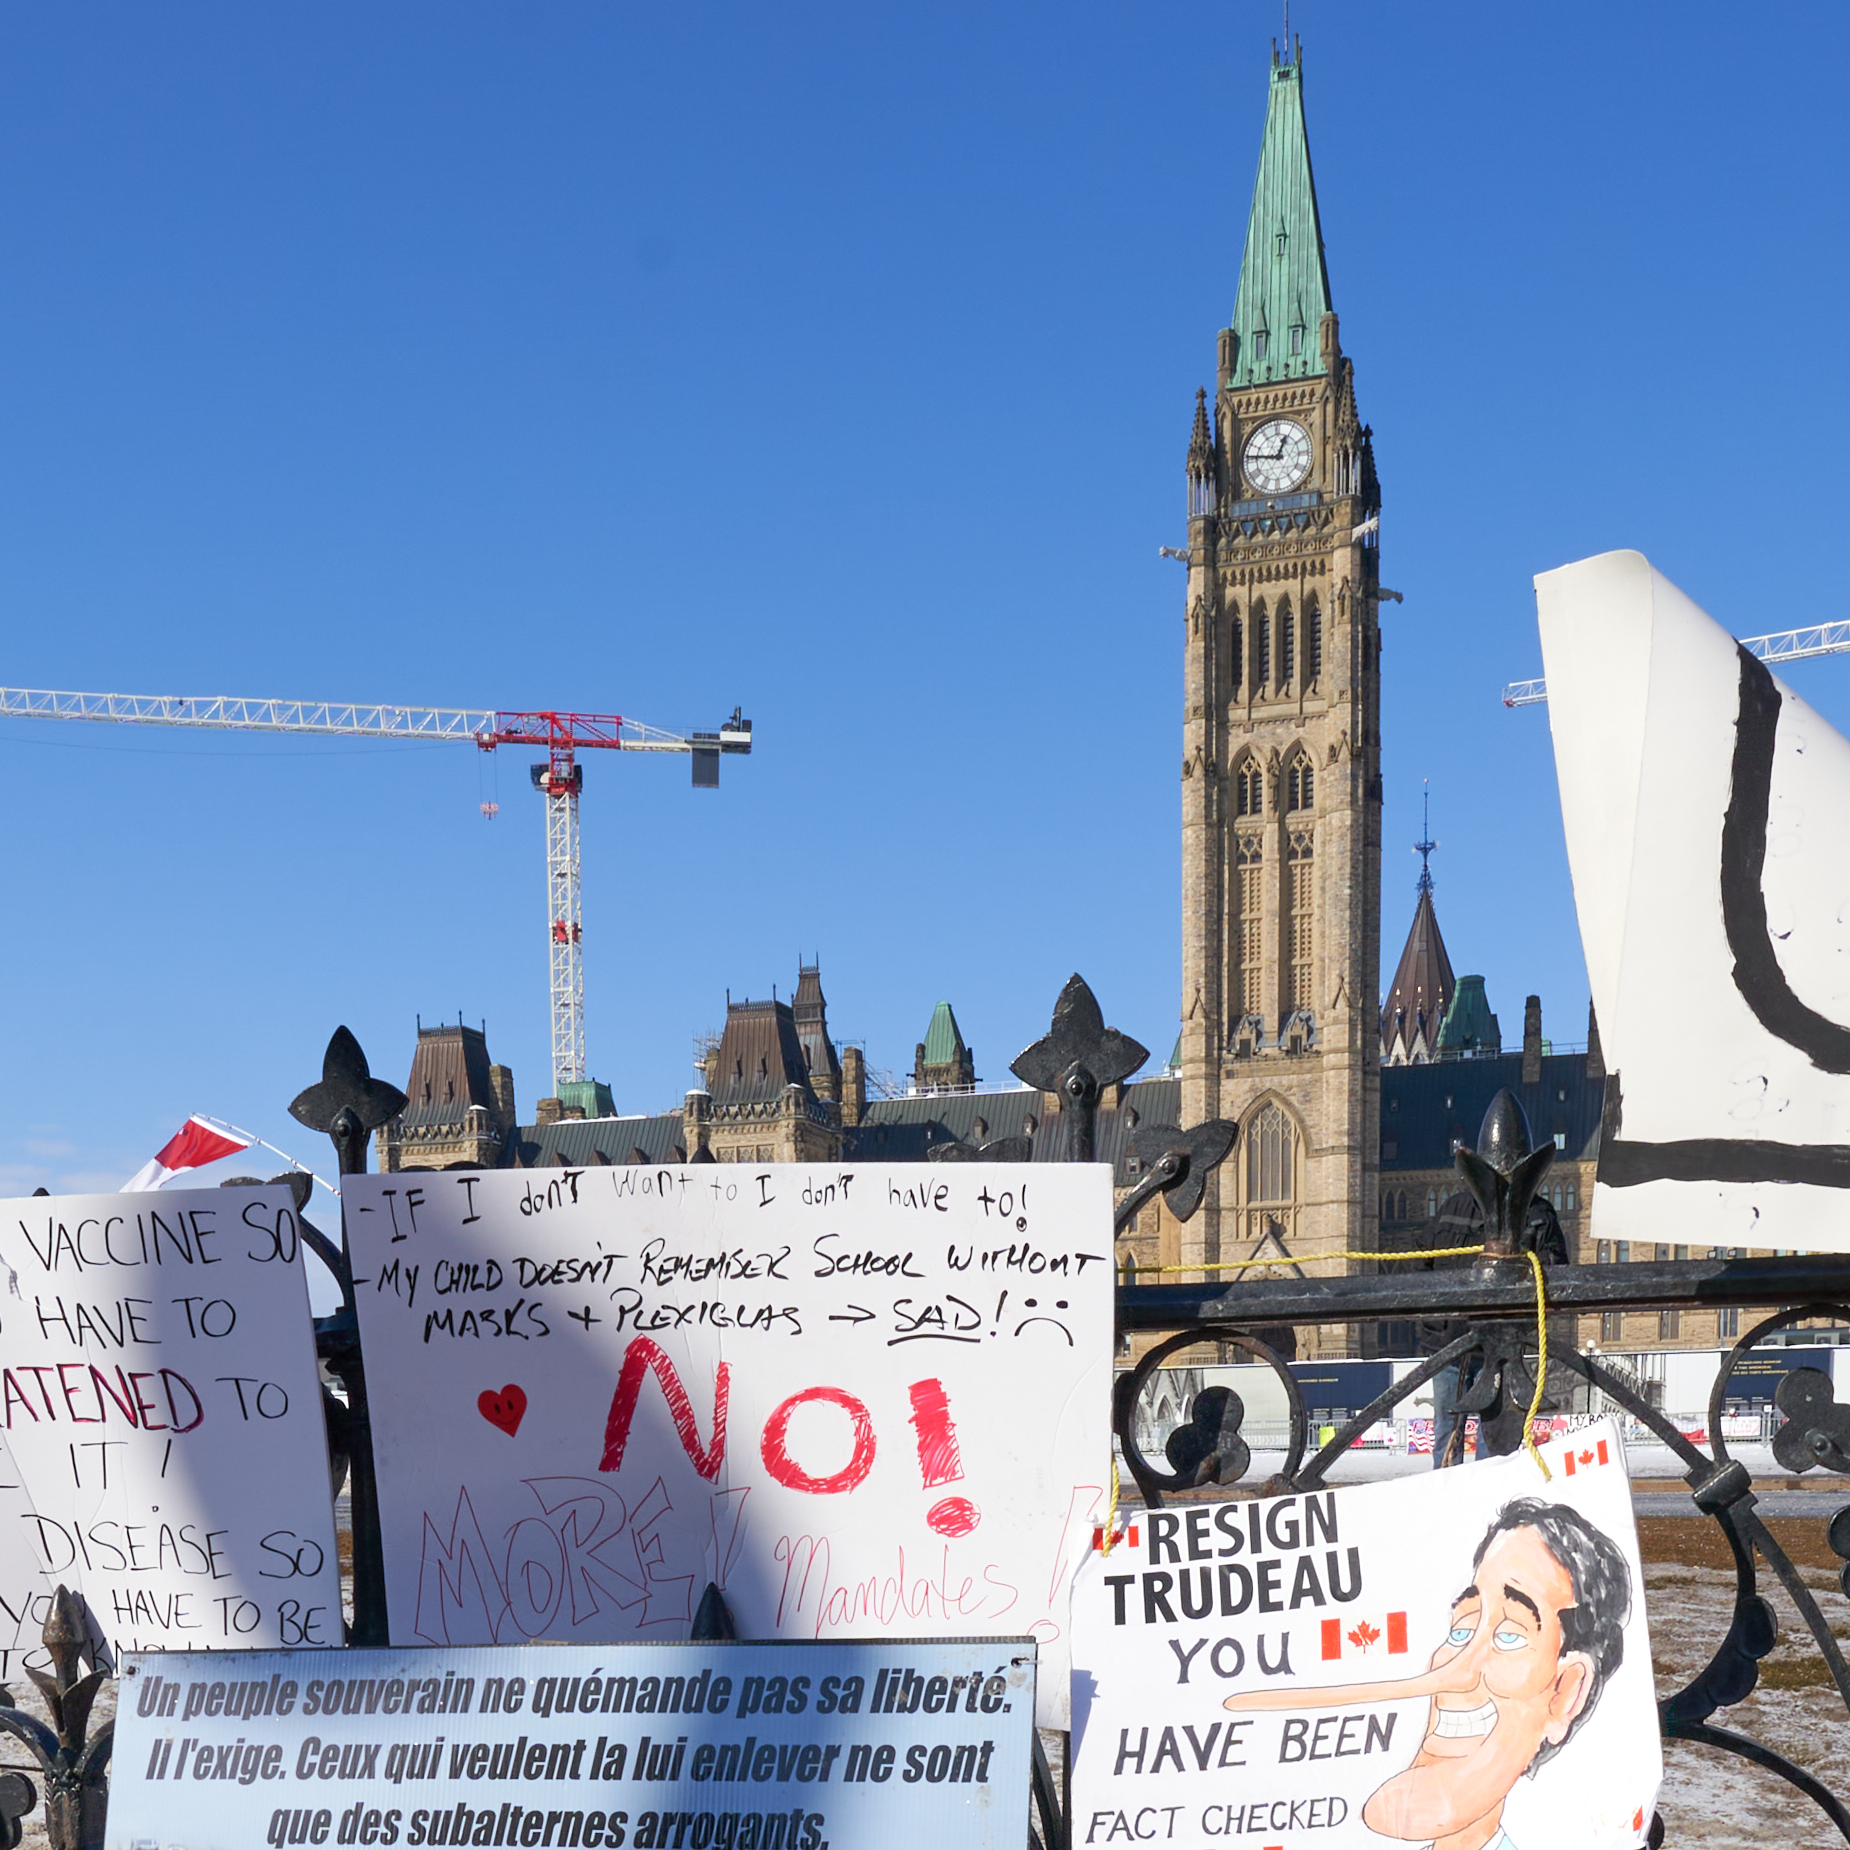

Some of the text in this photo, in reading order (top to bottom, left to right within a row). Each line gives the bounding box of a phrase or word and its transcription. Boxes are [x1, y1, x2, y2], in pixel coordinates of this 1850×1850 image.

[457, 1177, 482, 1225] I
[519, 1171, 586, 1216] don't
[710, 1175, 739, 1202] to
[756, 1175, 776, 1206] I
[801, 1173, 855, 1206] don't
[19, 1210, 222, 1273] VACCINE
[242, 1202, 296, 1263] SO
[434, 1259, 503, 1295] CHILD
[512, 1241, 629, 1287] DOESN'T
[813, 1234, 926, 1280] SCHOOL
[948, 1243, 1107, 1280] WITHOUT
[36, 1295, 161, 1349] HAVE
[172, 1296, 237, 1338] TO
[423, 1299, 553, 1344] MASKS
[888, 1294, 1005, 1345] SAD!
[215, 1377, 290, 1420] TO
[597, 1334, 982, 1539] NO!
[70, 1440, 128, 1490] IT
[21, 1513, 230, 1580] DISEASE
[259, 1529, 324, 1580] SO
[1148, 1491, 1339, 1565] RESIGN
[1104, 1546, 1363, 1626] TRUDEAU
[112, 1589, 327, 1646] HAVE TO BE
[1168, 1631, 1296, 1685] YOU
[137, 1667, 1013, 1723] Un peuple souverain ne quémande pas sa liberté.
[147, 1735, 994, 1785] Il l'exige. Ceux qui veulent la lui enlever ne sont
[1113, 1711, 1398, 1776] HAVE BEEN
[267, 1805, 332, 1850] que
[337, 1802, 400, 1846] des
[405, 1802, 627, 1849] subalternes
[1085, 1796, 1349, 1845] FACT CHECKED
